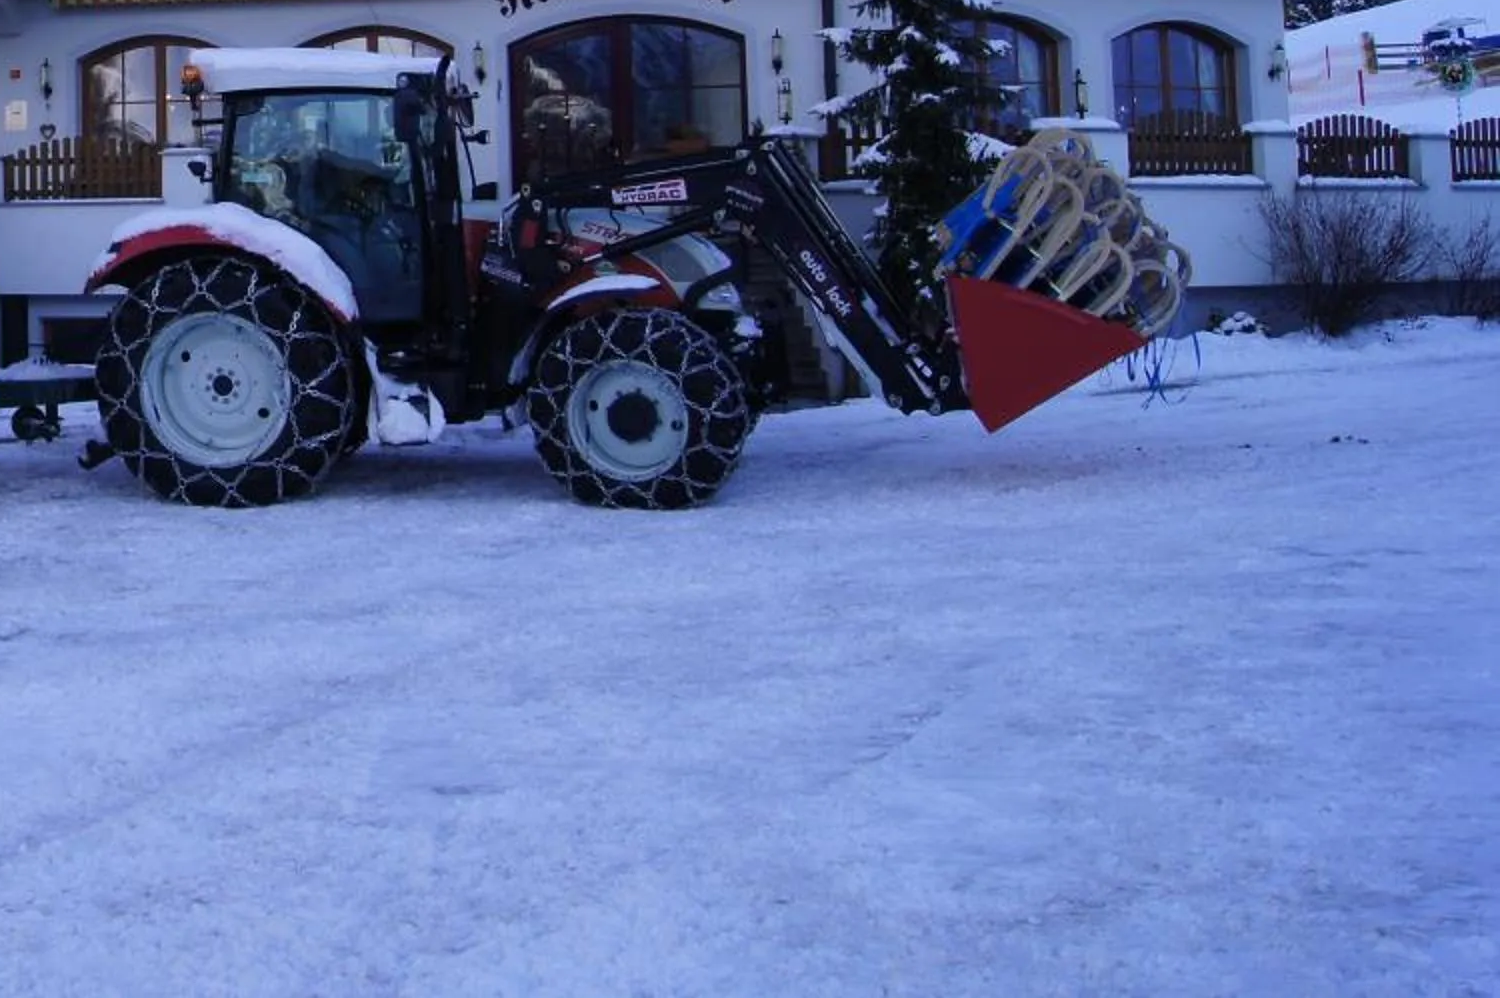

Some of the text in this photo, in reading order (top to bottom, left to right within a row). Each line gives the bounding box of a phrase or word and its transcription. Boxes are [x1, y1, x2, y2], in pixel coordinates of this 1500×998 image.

[621, 188, 682, 202] HYDRAC
[801, 250, 853, 317] auto lock
